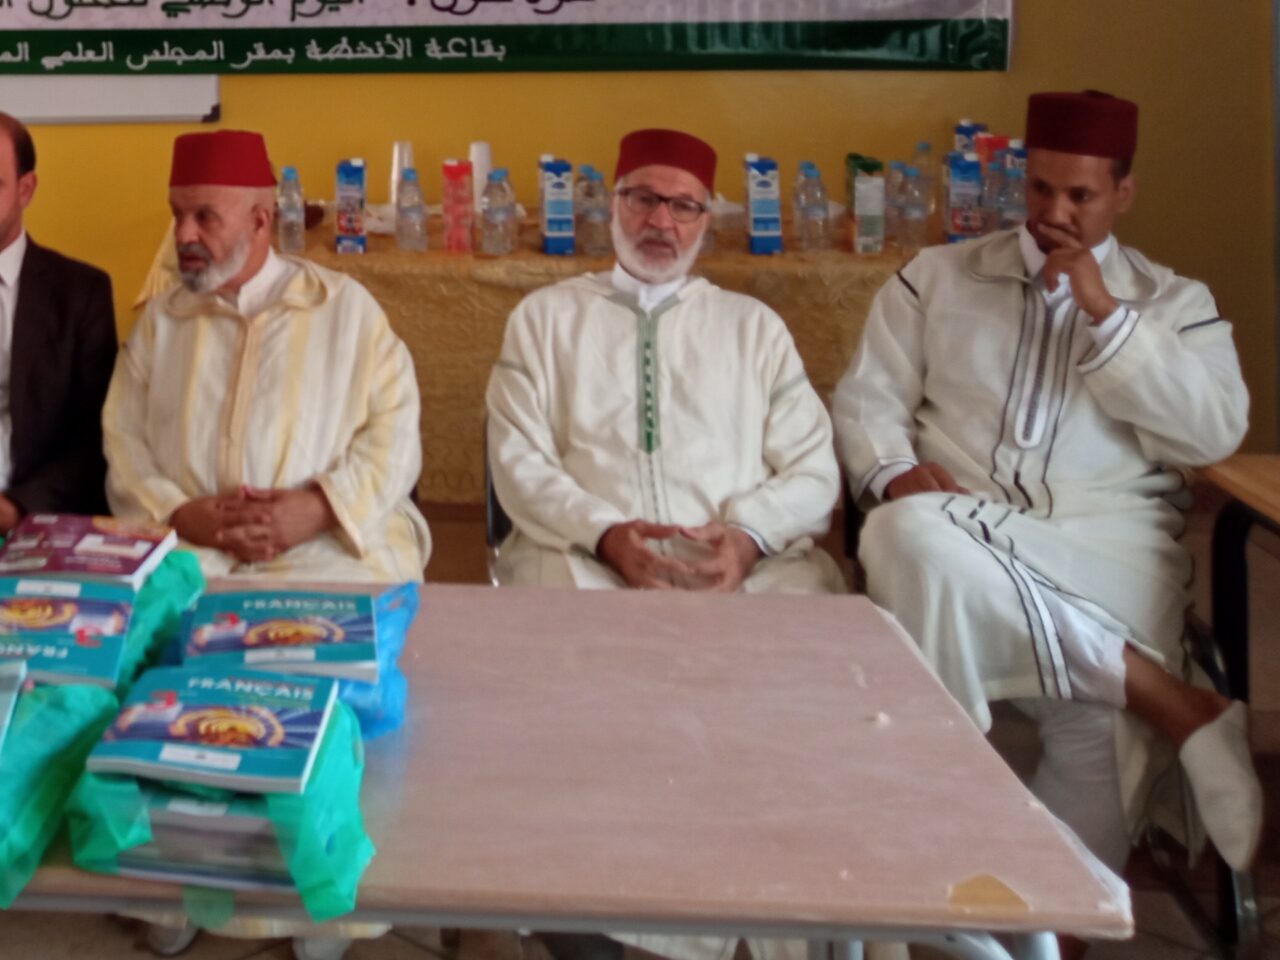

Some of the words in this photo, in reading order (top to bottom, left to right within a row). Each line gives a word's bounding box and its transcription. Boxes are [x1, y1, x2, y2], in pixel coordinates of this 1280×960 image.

[41, 42, 114, 70] العلمي
[126, 40, 224, 70] المجلس
[230, 42, 295, 69] بمقر
[306, 34, 412, 61] الأنشطة
[425, 38, 505, 61] بقاعة
